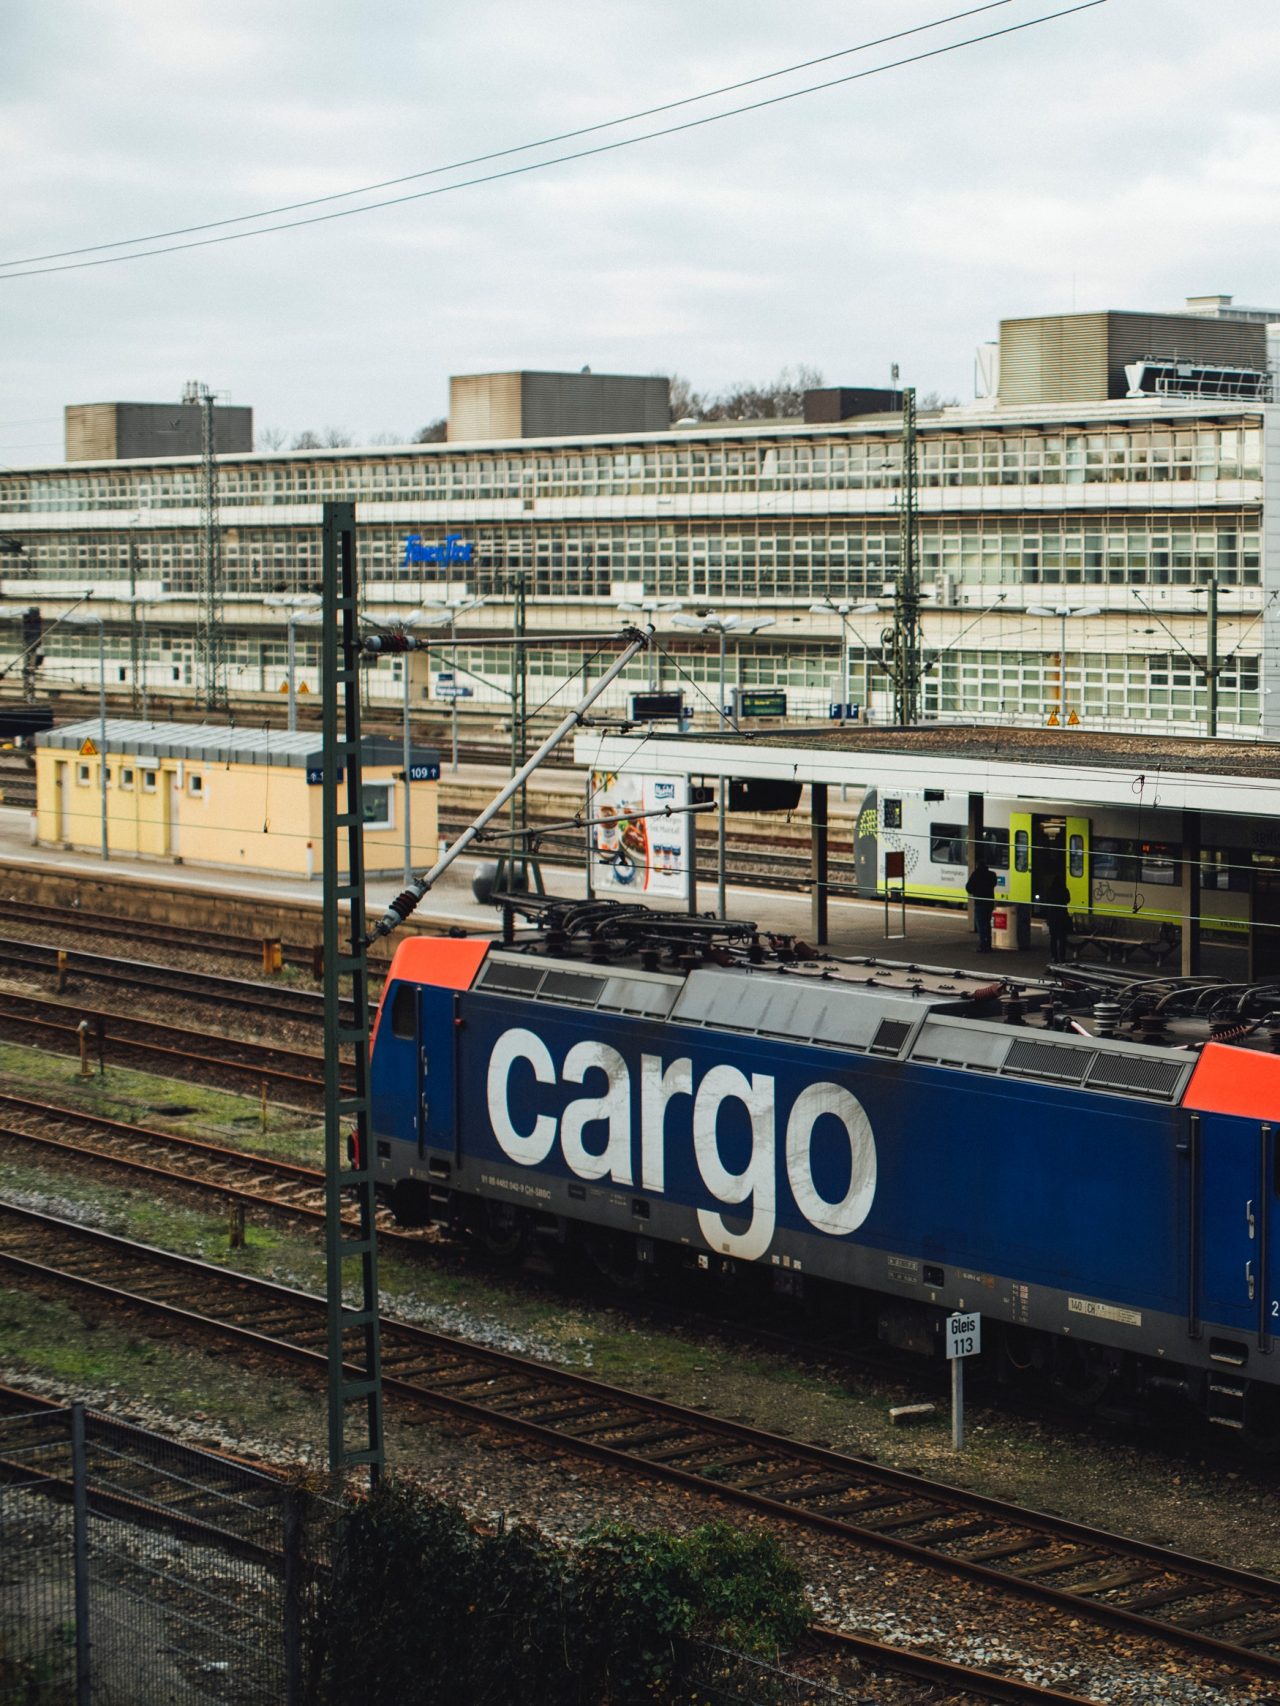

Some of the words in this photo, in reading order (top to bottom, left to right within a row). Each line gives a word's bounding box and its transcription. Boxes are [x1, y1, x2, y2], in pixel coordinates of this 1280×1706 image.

[831, 703, 839, 716] F
[851, 703, 859, 716] F
[411, 767, 428, 779] 109
[487, 1028, 878, 1260] cargo
[1271, 1300, 1279, 1317] 2
[951, 1316, 976, 1335] Gleis
[953, 1337, 974, 1356] 113
